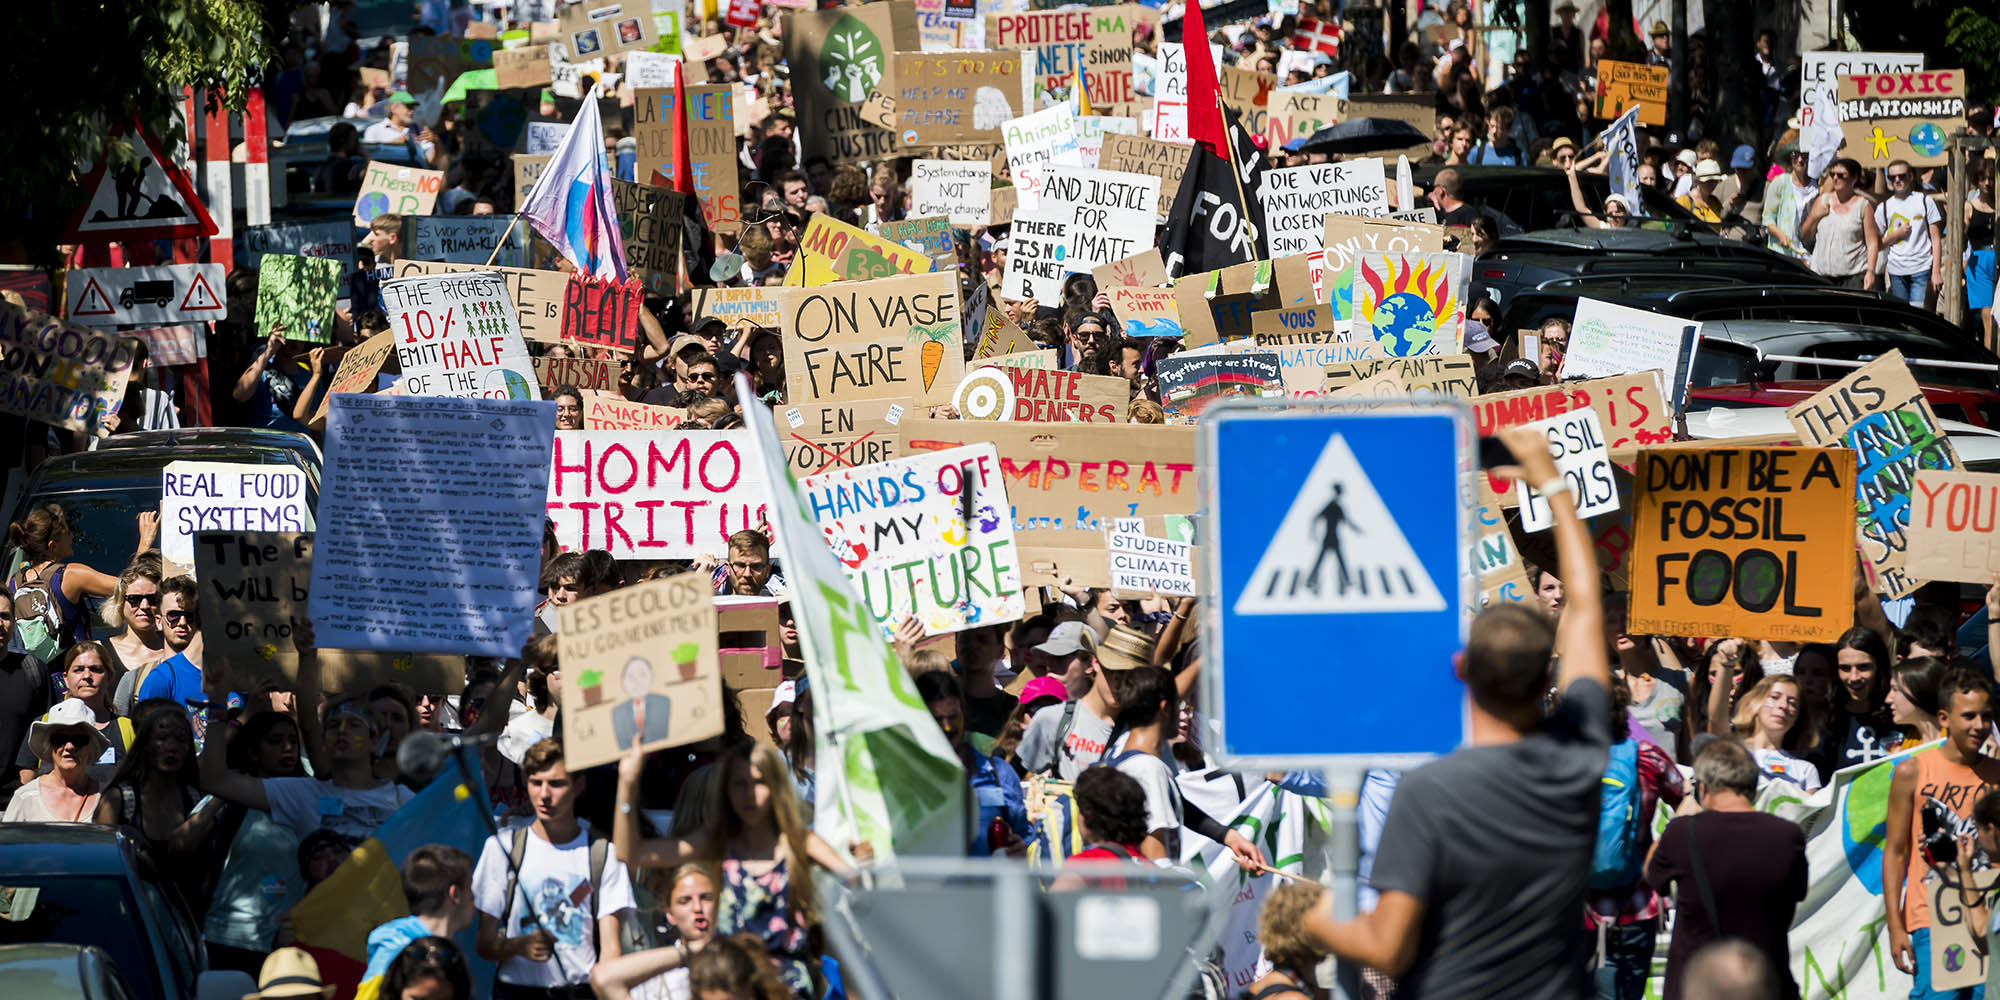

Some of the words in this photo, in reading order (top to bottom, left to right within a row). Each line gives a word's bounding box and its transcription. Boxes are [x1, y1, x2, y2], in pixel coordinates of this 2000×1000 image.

[999, 12, 1093, 45] PROTEGE
[1096, 16, 1125, 32] MA
[1804, 62, 1826, 82] LE
[1851, 73, 1953, 96] TOXIC
[901, 86, 943, 100] HELP
[947, 86, 969, 100] ME
[1285, 96, 1322, 112] ACT
[635, 96, 655, 123] LA
[903, 108, 961, 126] PLEASE
[1839, 98, 1964, 122] RELATIONSHIP
[1008, 114, 1071, 147] Animals
[831, 132, 898, 161] JUSTICE
[1116, 138, 1188, 167] CLIMATE
[1118, 156, 1184, 182] INACTIO
[1270, 171, 1298, 190] DIE
[1309, 166, 1352, 186] VER-
[416, 175, 441, 193] NO
[939, 183, 970, 199] NOT
[1084, 180, 1150, 211] JUSTICE
[919, 202, 953, 215] Climate
[1266, 185, 1385, 213] ANTWORTUNGS-
[1014, 219, 1066, 237] THERE
[1074, 206, 1108, 231] FOR
[658, 222, 682, 250] NOT
[1015, 238, 1040, 259] IS
[1273, 237, 1308, 252] SIND
[1013, 257, 1065, 281] PLANET
[389, 282, 432, 308] THE
[440, 279, 502, 301] RICHEST
[1022, 279, 1035, 298] B
[544, 301, 558, 318] IS
[564, 279, 637, 348] REAL
[795, 292, 859, 342] ON
[868, 293, 954, 328] VASE
[1279, 308, 1317, 329] VOUS
[39, 323, 133, 373] GOOD
[399, 343, 439, 368] EMIT
[441, 336, 504, 371] HALF
[408, 374, 432, 395] OF
[443, 371, 478, 392] THE
[546, 358, 610, 391] RUSSIA
[804, 343, 907, 399] FAIRE
[1161, 360, 1207, 384] Together
[1208, 359, 1222, 367] we
[1226, 359, 1240, 367] are
[1242, 356, 1277, 377] strong
[822, 407, 854, 435] EN
[1795, 375, 1885, 444] THIS
[554, 436, 741, 498] HOMO
[1749, 449, 1797, 492] BE
[1801, 451, 1842, 490] A
[165, 472, 224, 497] REAL
[240, 473, 300, 499] FOOD
[809, 471, 926, 522] HANDS
[178, 504, 301, 536] SYSTEMS
[1661, 497, 1807, 542] FOSSIL
[1916, 479, 1998, 533] YOU
[874, 513, 924, 551] MY
[1118, 521, 1142, 534] UK
[1112, 534, 1187, 558] STUDENT
[1114, 555, 1189, 576] CLIMATE
[1120, 574, 1193, 593] NETWORK
[1656, 548, 1823, 618] FOOL
[559, 603, 600, 637] LES
[609, 576, 702, 625] ECOLOS
